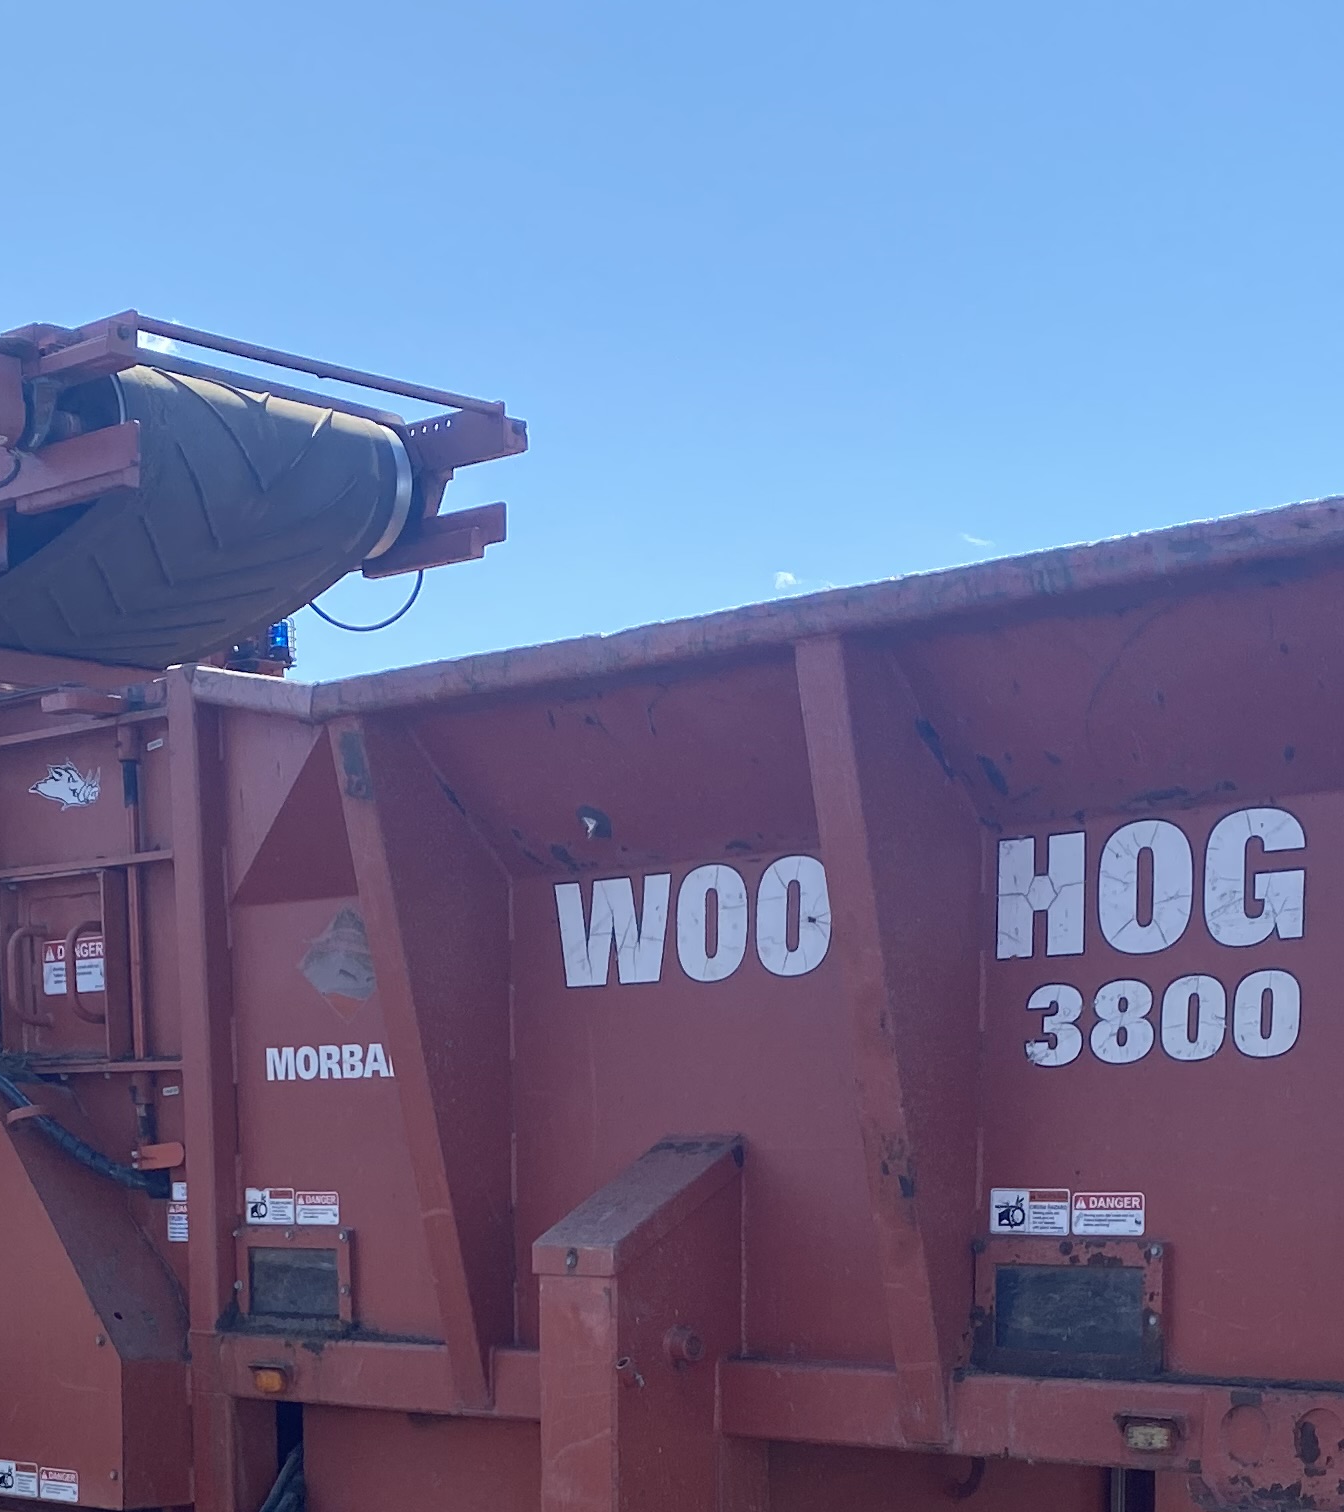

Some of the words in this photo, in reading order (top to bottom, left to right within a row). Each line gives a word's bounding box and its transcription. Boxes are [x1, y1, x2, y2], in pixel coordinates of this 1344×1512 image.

[554, 854, 832, 988] WOO
[996, 806, 1307, 961] HOG
[57, 942, 104, 960] DNGER
[1024, 968, 1303, 1068] 3800
[266, 1043, 394, 1081] MORBA
[305, 1195, 336, 1204] DANGER
[1089, 1197, 1141, 1209] DANGER
